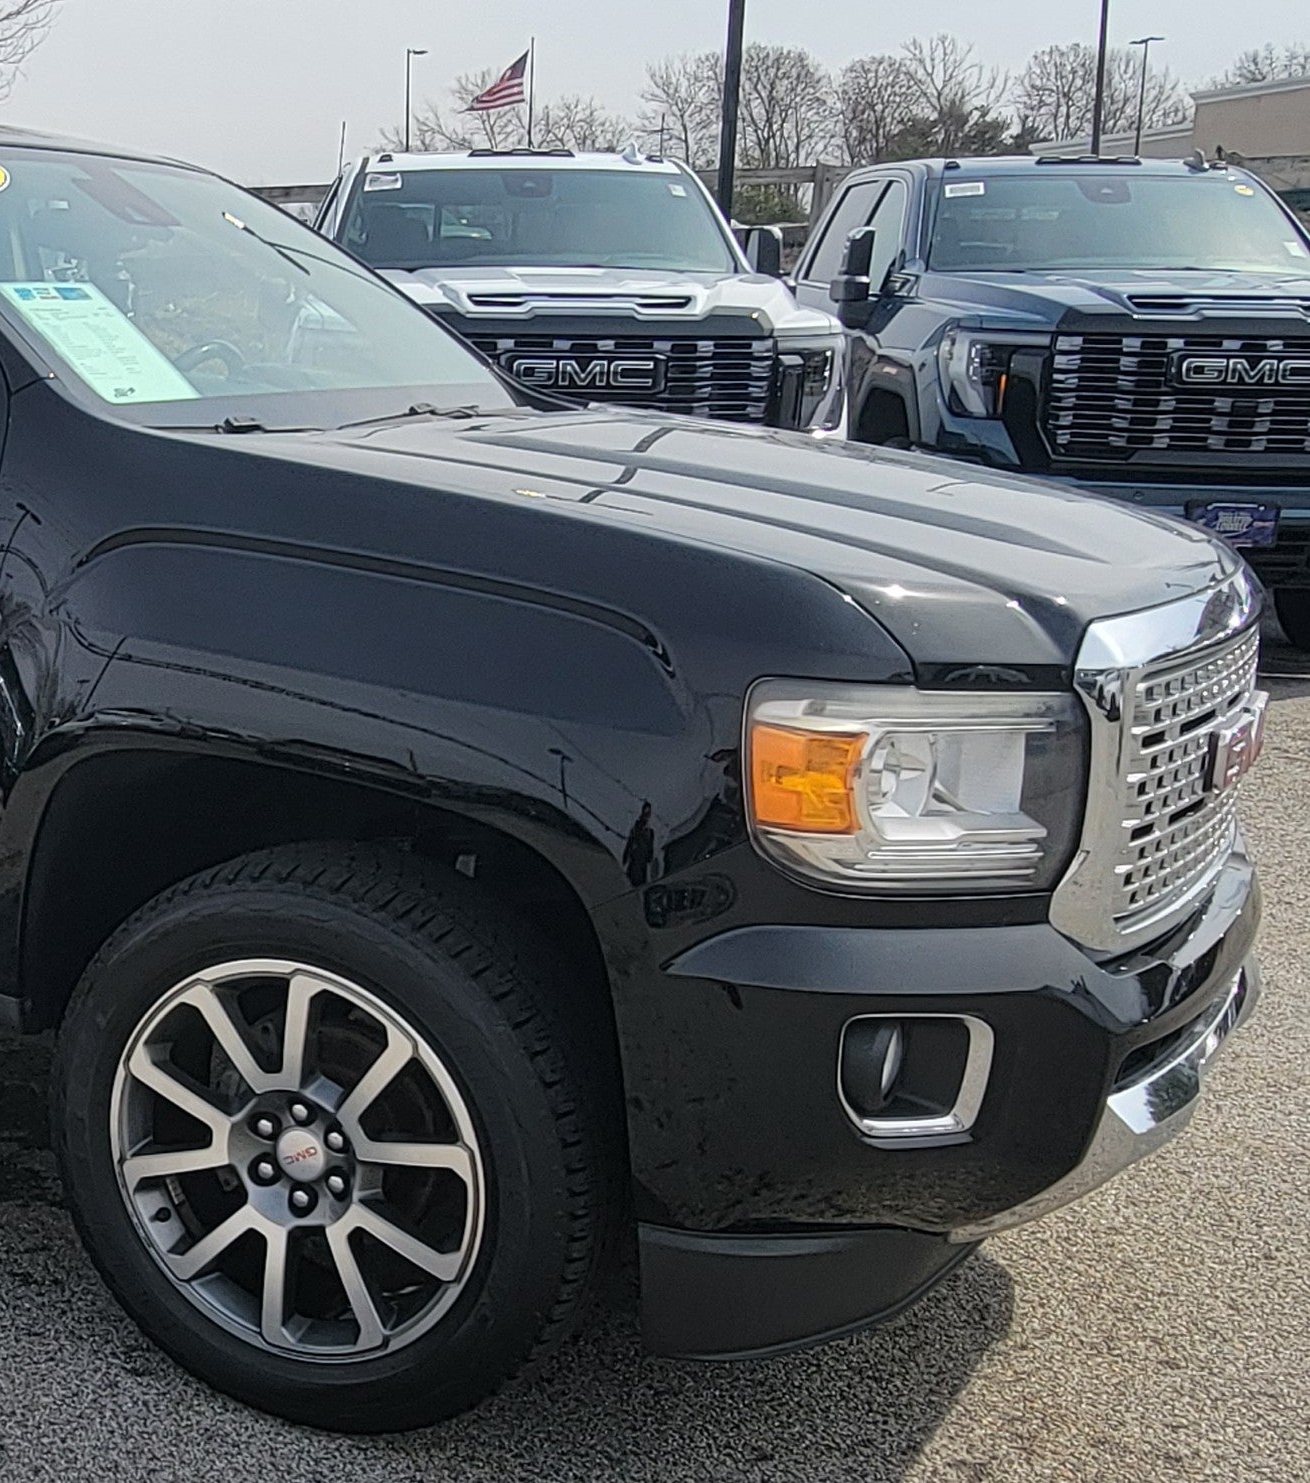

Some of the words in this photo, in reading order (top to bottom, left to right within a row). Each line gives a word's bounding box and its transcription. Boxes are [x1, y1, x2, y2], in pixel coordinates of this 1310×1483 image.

[513, 359, 654, 386] GMC
[1182, 358, 1310, 384] GMC
[283, 1146, 317, 1164] GMC
